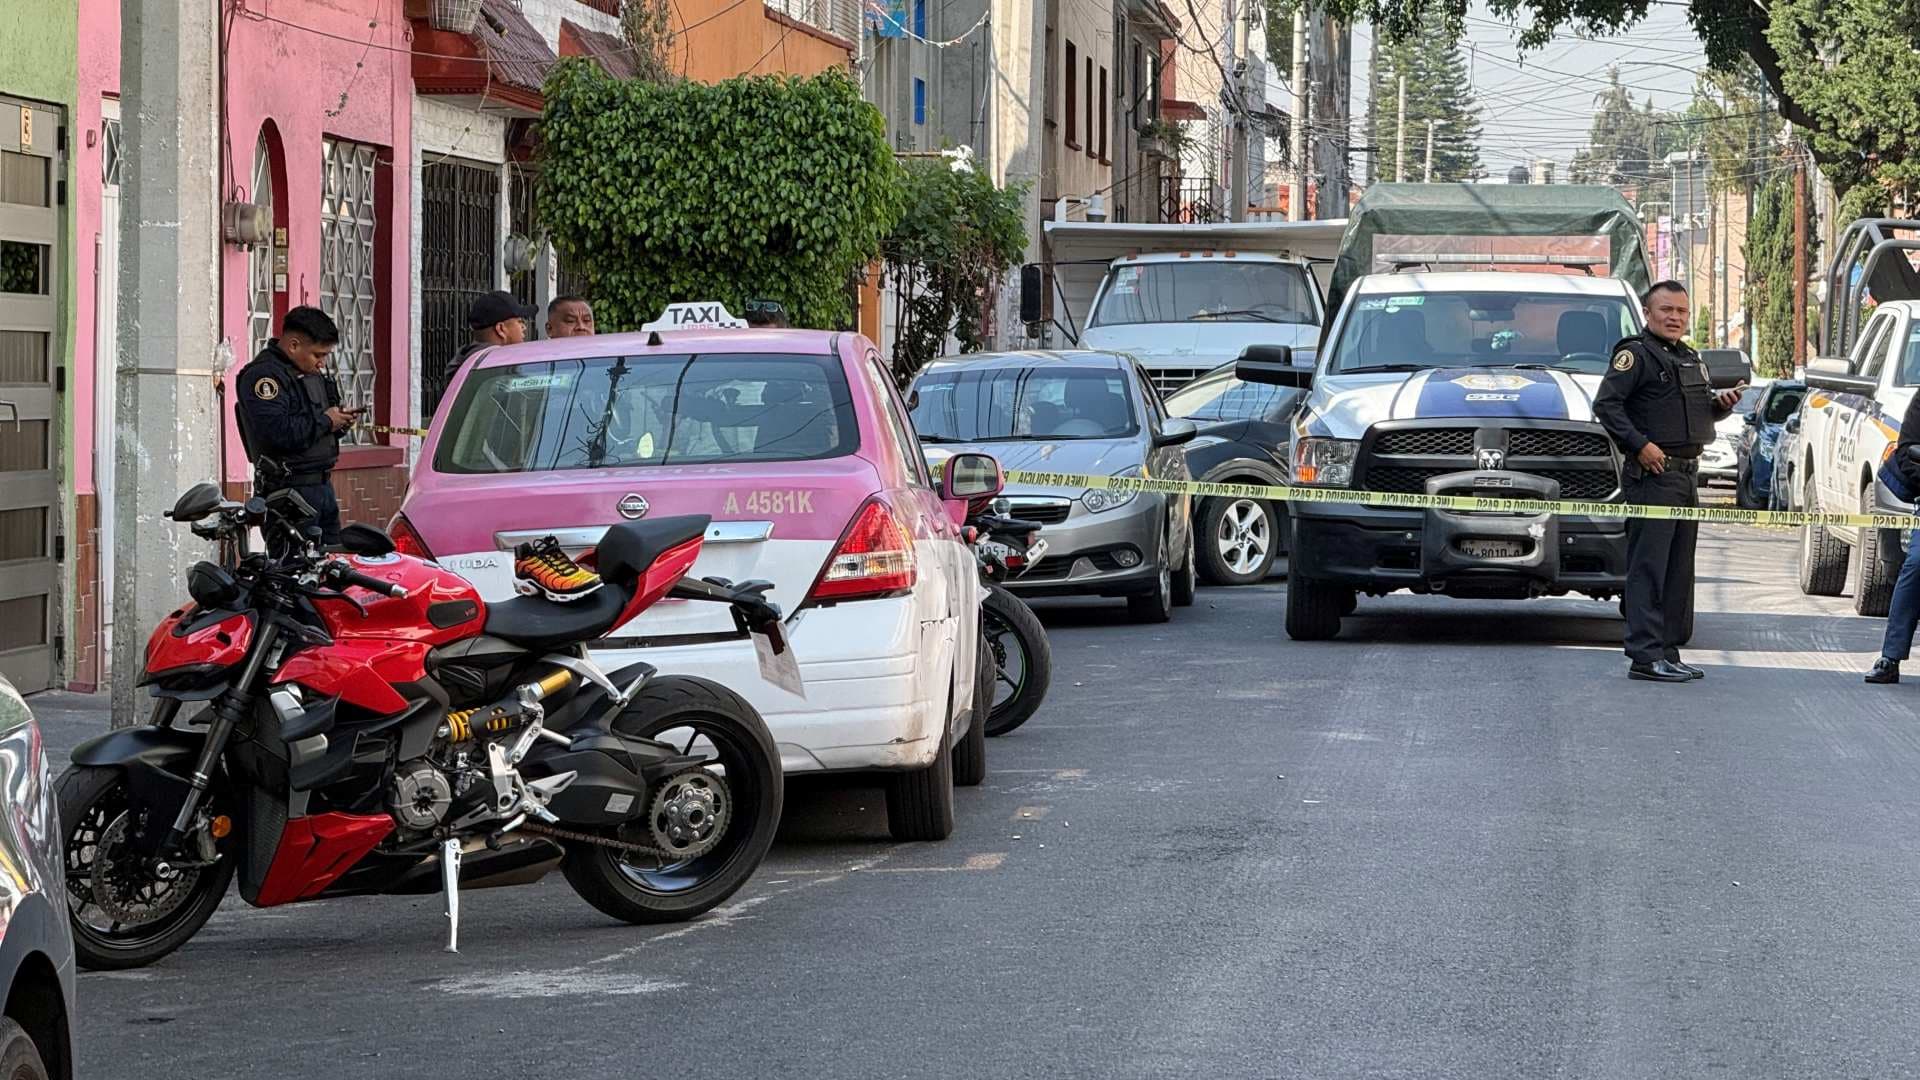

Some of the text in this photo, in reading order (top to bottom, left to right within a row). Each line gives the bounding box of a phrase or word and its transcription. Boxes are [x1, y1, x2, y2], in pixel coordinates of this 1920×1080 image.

[668, 306, 720, 324] TAXI
[723, 490, 815, 515] A 4581K
